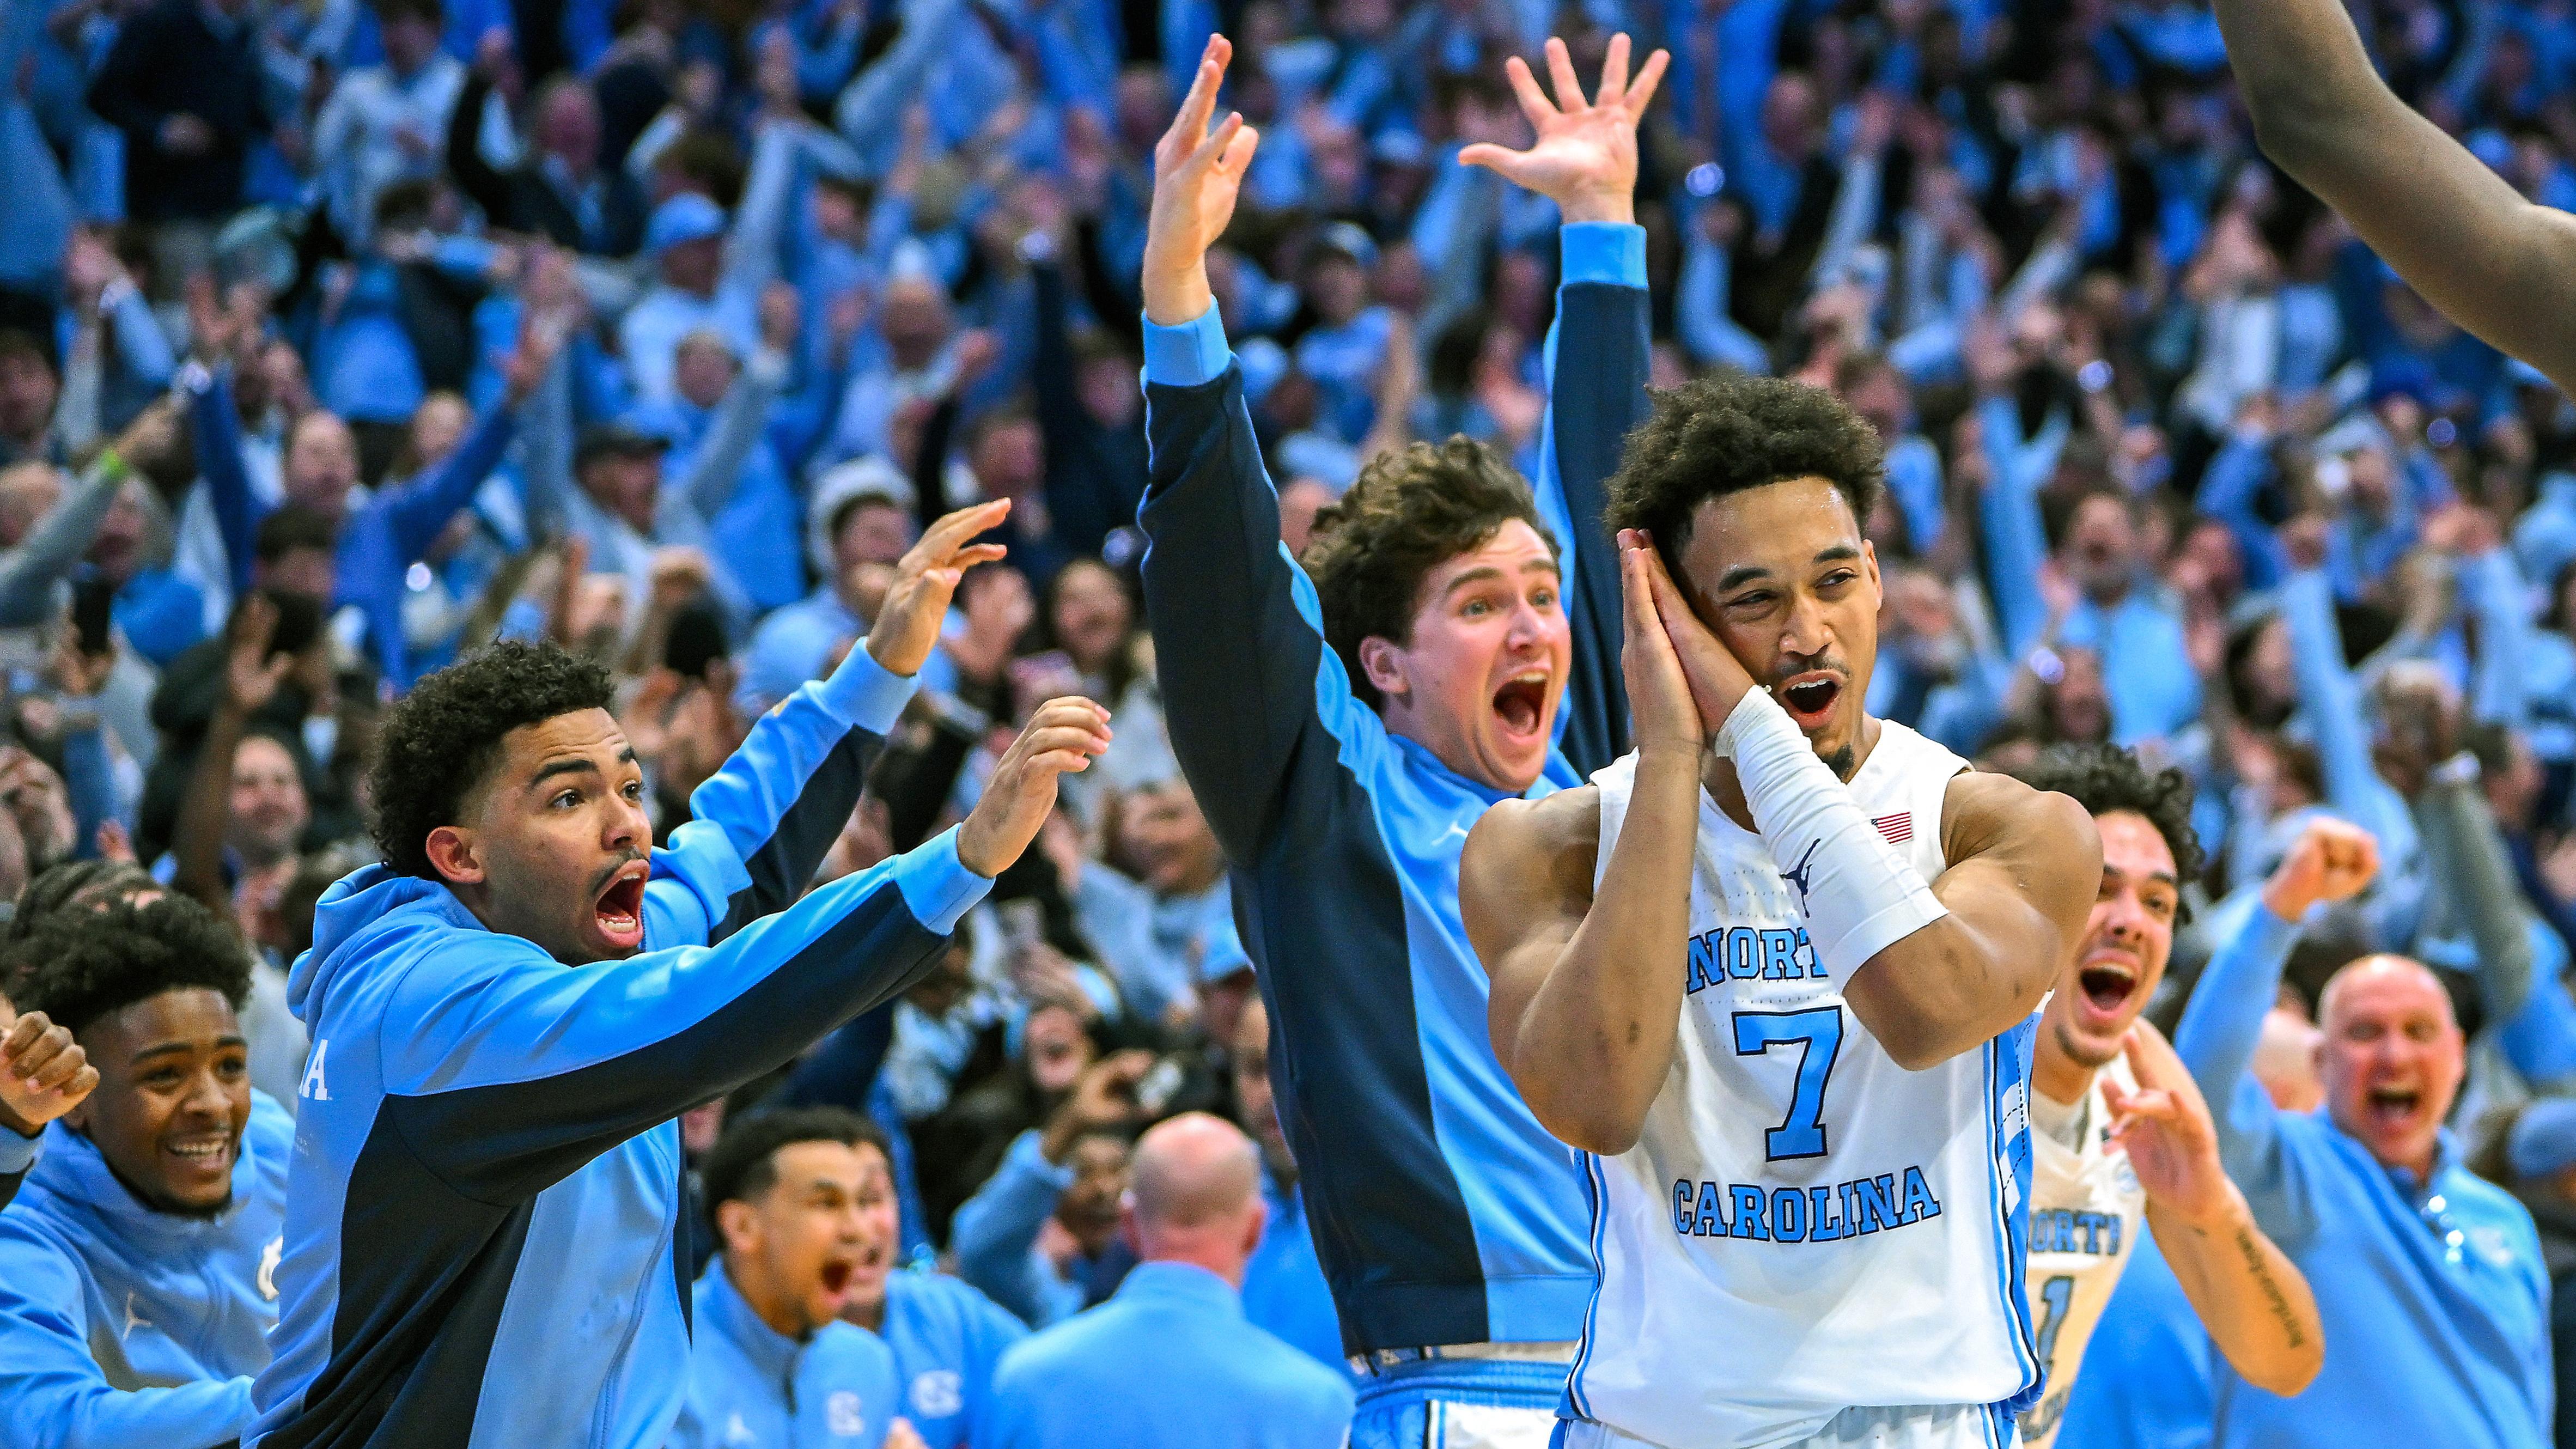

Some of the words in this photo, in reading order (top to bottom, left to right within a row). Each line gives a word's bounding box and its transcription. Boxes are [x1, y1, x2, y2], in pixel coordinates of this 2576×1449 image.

[1686, 926, 1829, 995] NOR
[1732, 1005, 1843, 1162] 7
[1672, 1165, 1942, 1244] CAROLINA
